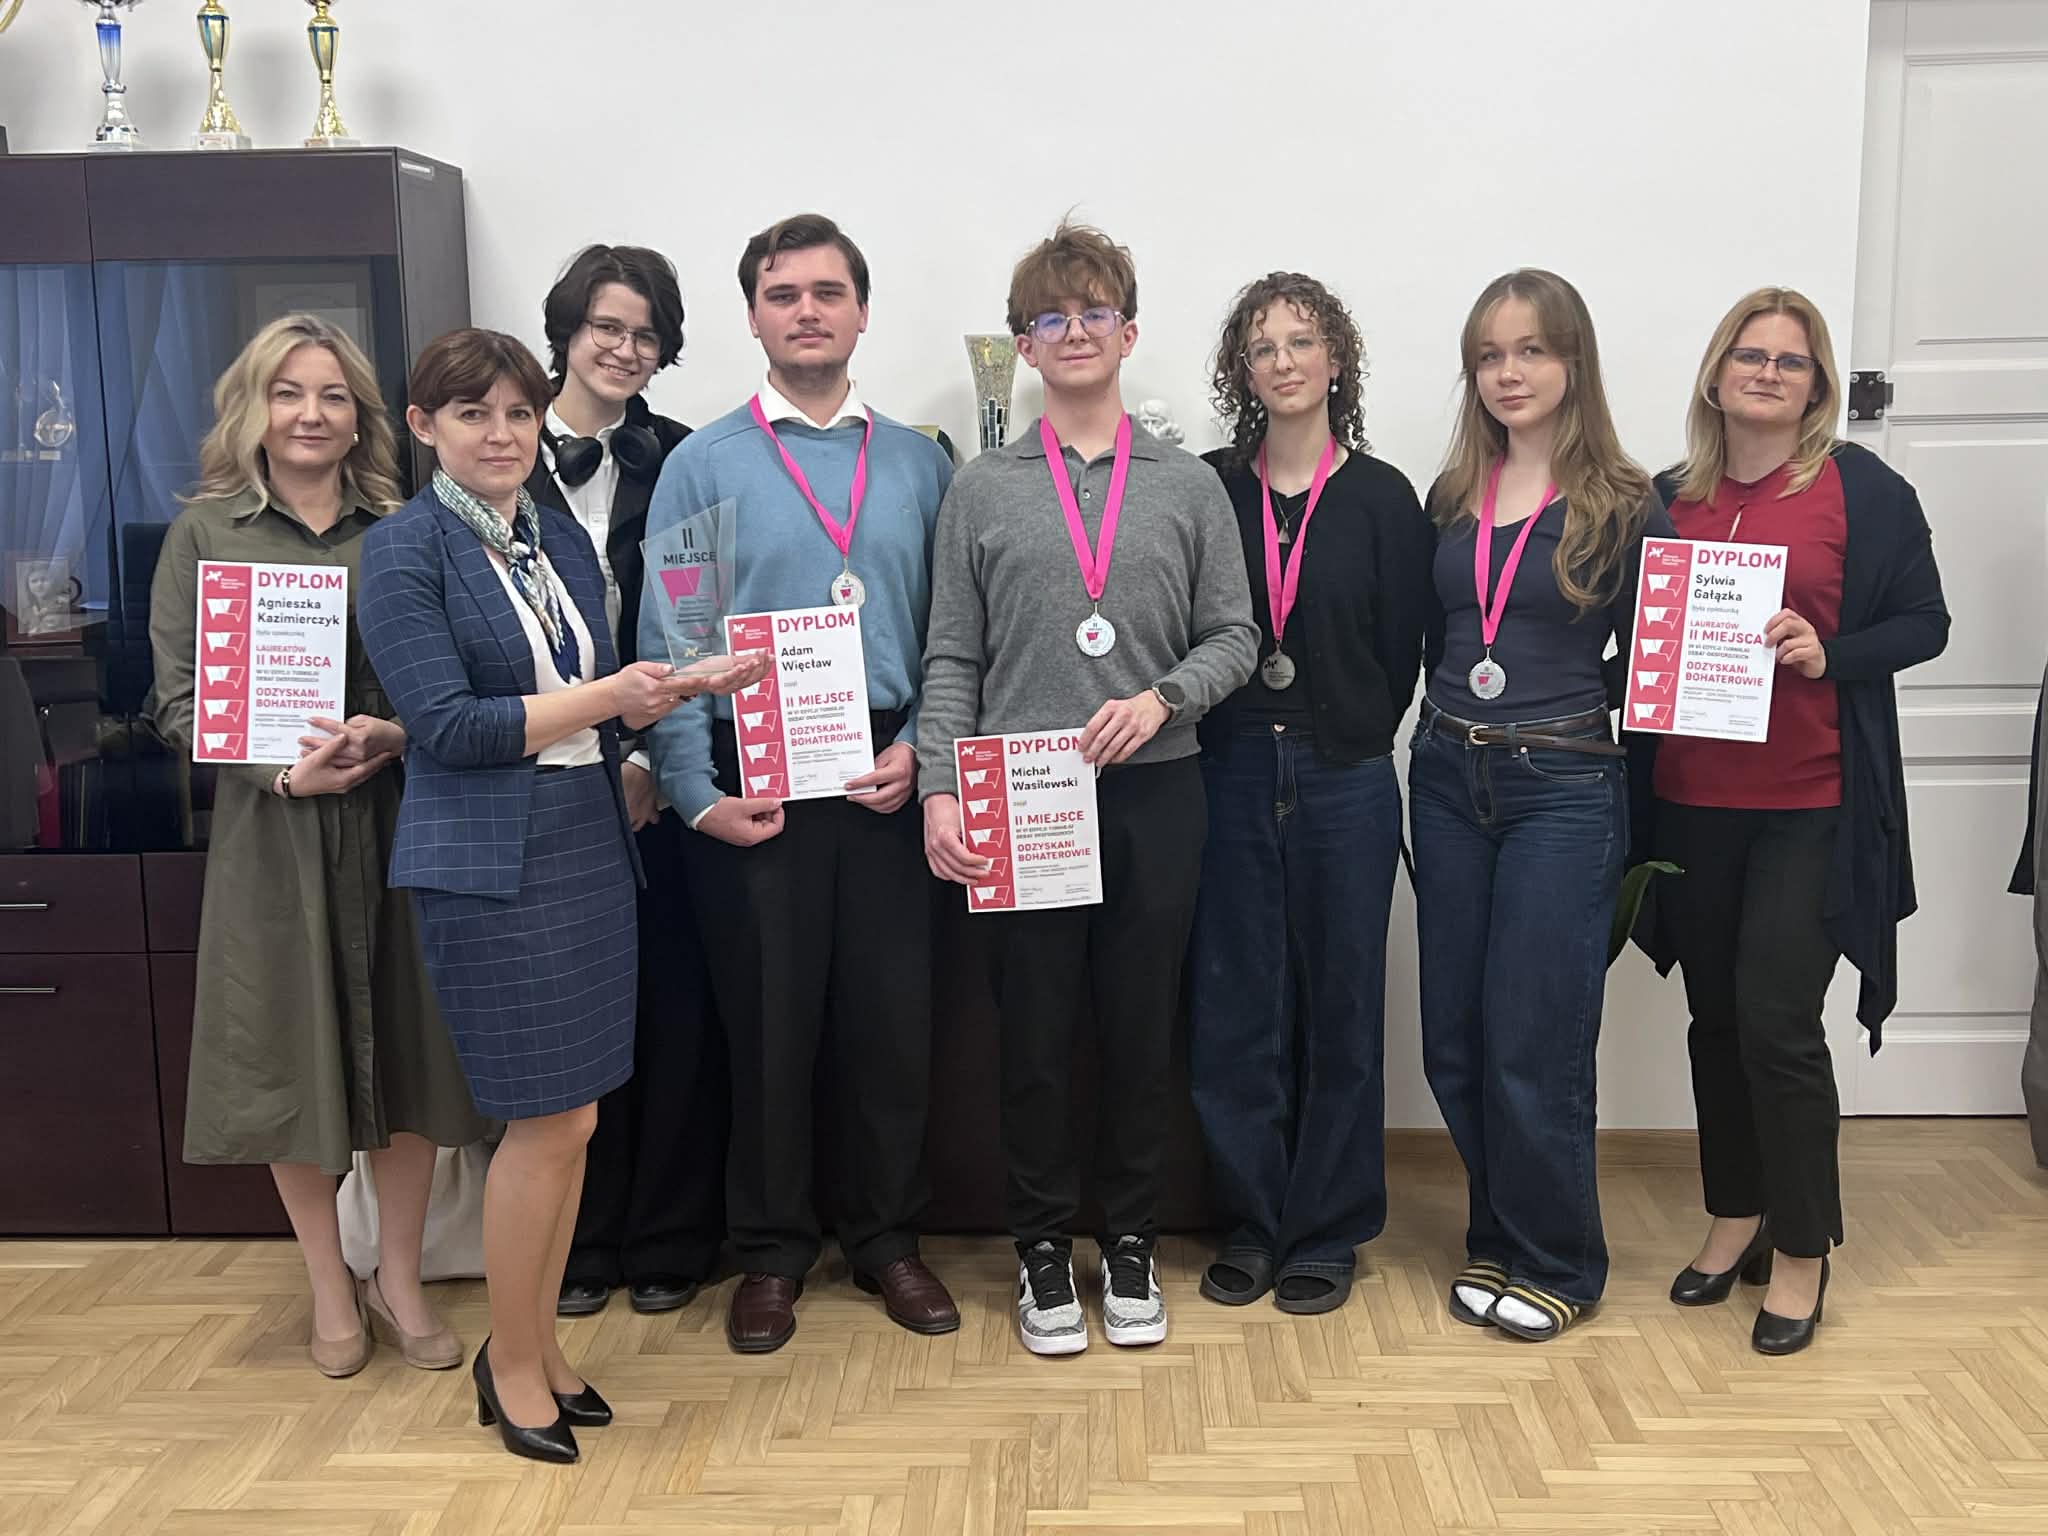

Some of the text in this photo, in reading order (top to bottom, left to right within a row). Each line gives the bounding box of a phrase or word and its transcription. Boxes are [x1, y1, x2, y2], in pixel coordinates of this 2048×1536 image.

[682, 527, 694, 549] II
[663, 551, 717, 565] MIEJSCE
[1697, 549, 1782, 569] DYPLOM
[258, 572, 343, 590] DYPLOM
[1695, 574, 1736, 587] Sylwia
[1694, 588, 1743, 603] Gałązka
[257, 597, 321, 610] Agnieszka
[257, 612, 340, 627] Kazimierczyk
[777, 611, 855, 633] DYPLOM
[1689, 629, 1763, 645] II MIEJSCA
[781, 645, 814, 657] Adam
[256, 654, 332, 668] II MIEJSCA
[782, 658, 832, 673] Więcław
[1686, 661, 1748, 674] ODZYSKANI
[1685, 672, 1764, 687] BOHATEROWIE
[256, 687, 319, 698] ODZYSKANI
[786, 690, 855, 707] II MIEJSCE
[256, 699, 336, 710] BOHATEROWIE
[790, 723, 847, 736] ODZYSKANI
[791, 731, 864, 747] BOHATEROWIE
[1011, 765, 1051, 778] Michał
[1012, 777, 1078, 791] Wasilewski
[1015, 810, 1085, 826] II MIEJSCE
[1017, 840, 1075, 852] ODZYSKANI
[1018, 848, 1091, 862] BOHATEROWIE
